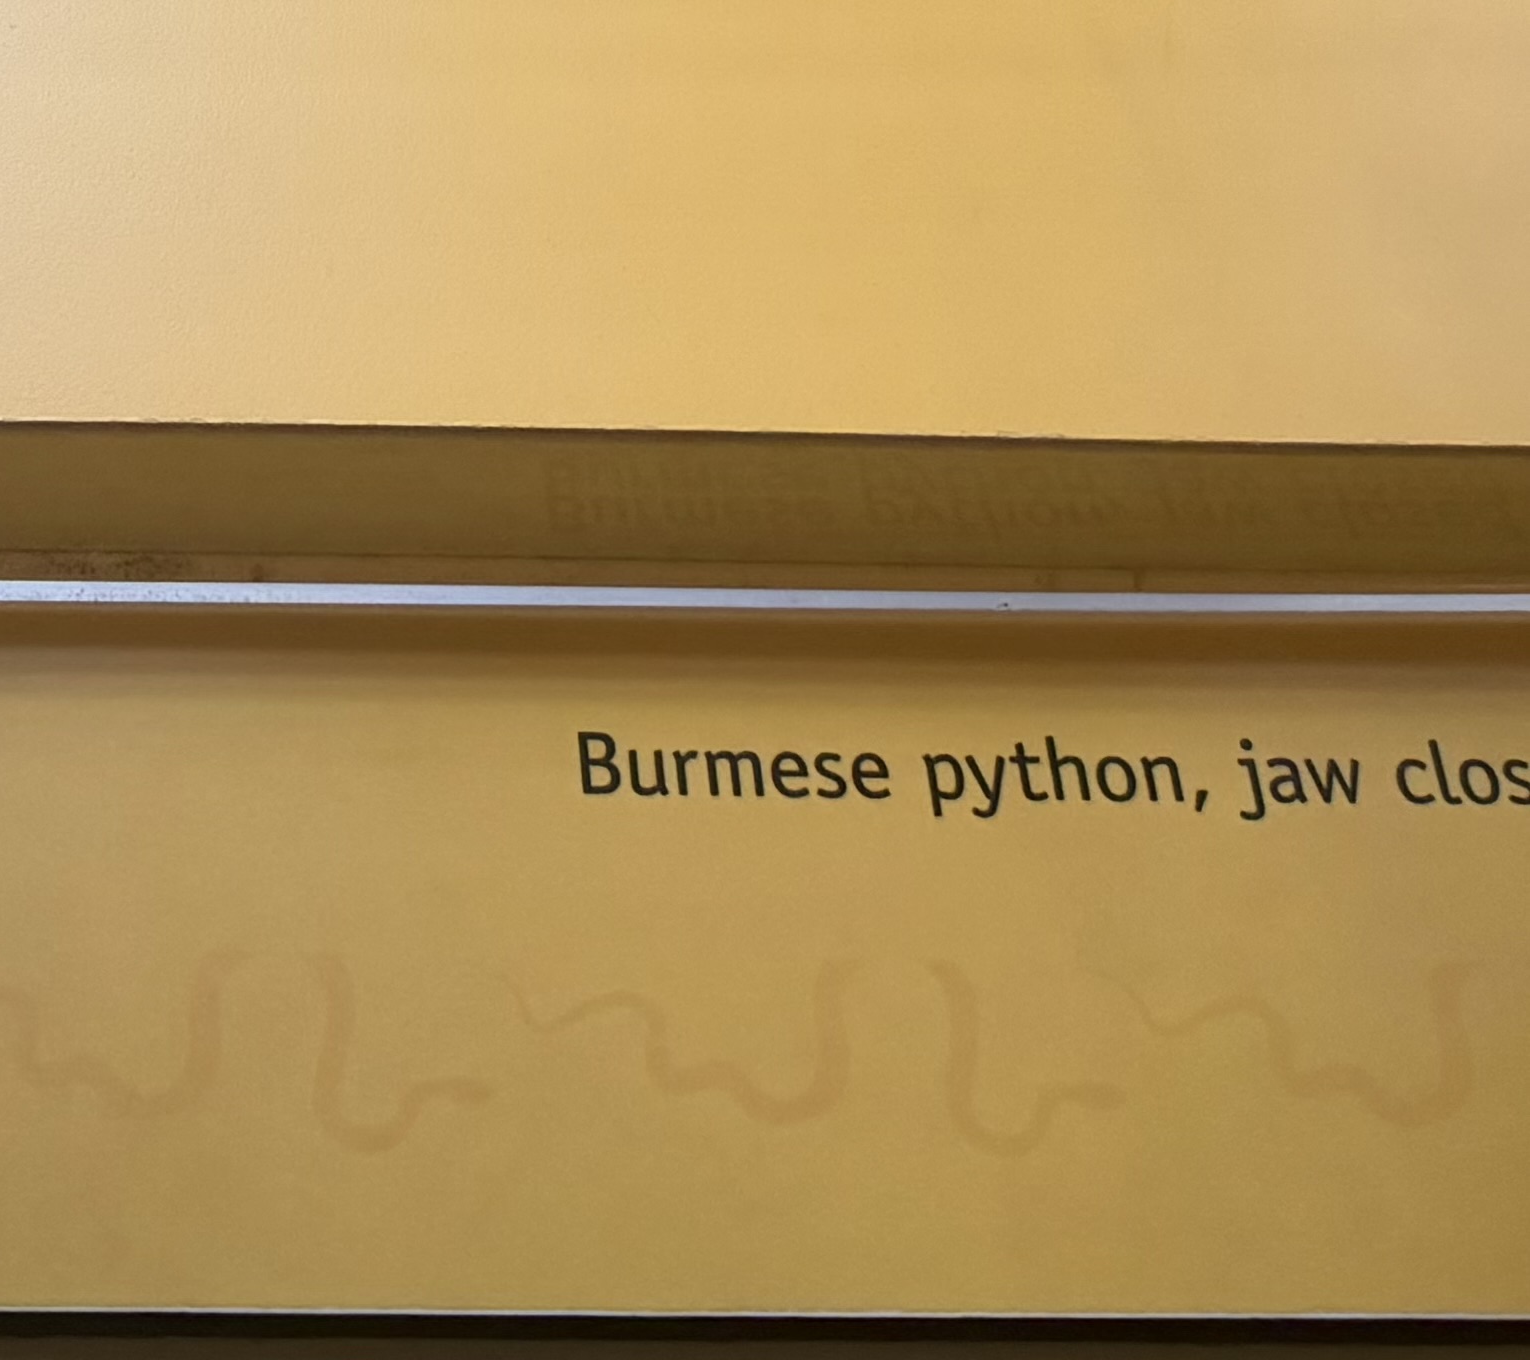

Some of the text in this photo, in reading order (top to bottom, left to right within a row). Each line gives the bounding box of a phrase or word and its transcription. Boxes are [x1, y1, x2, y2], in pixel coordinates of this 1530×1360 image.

[576, 730, 1530, 822] Burmese python, jaw clos
